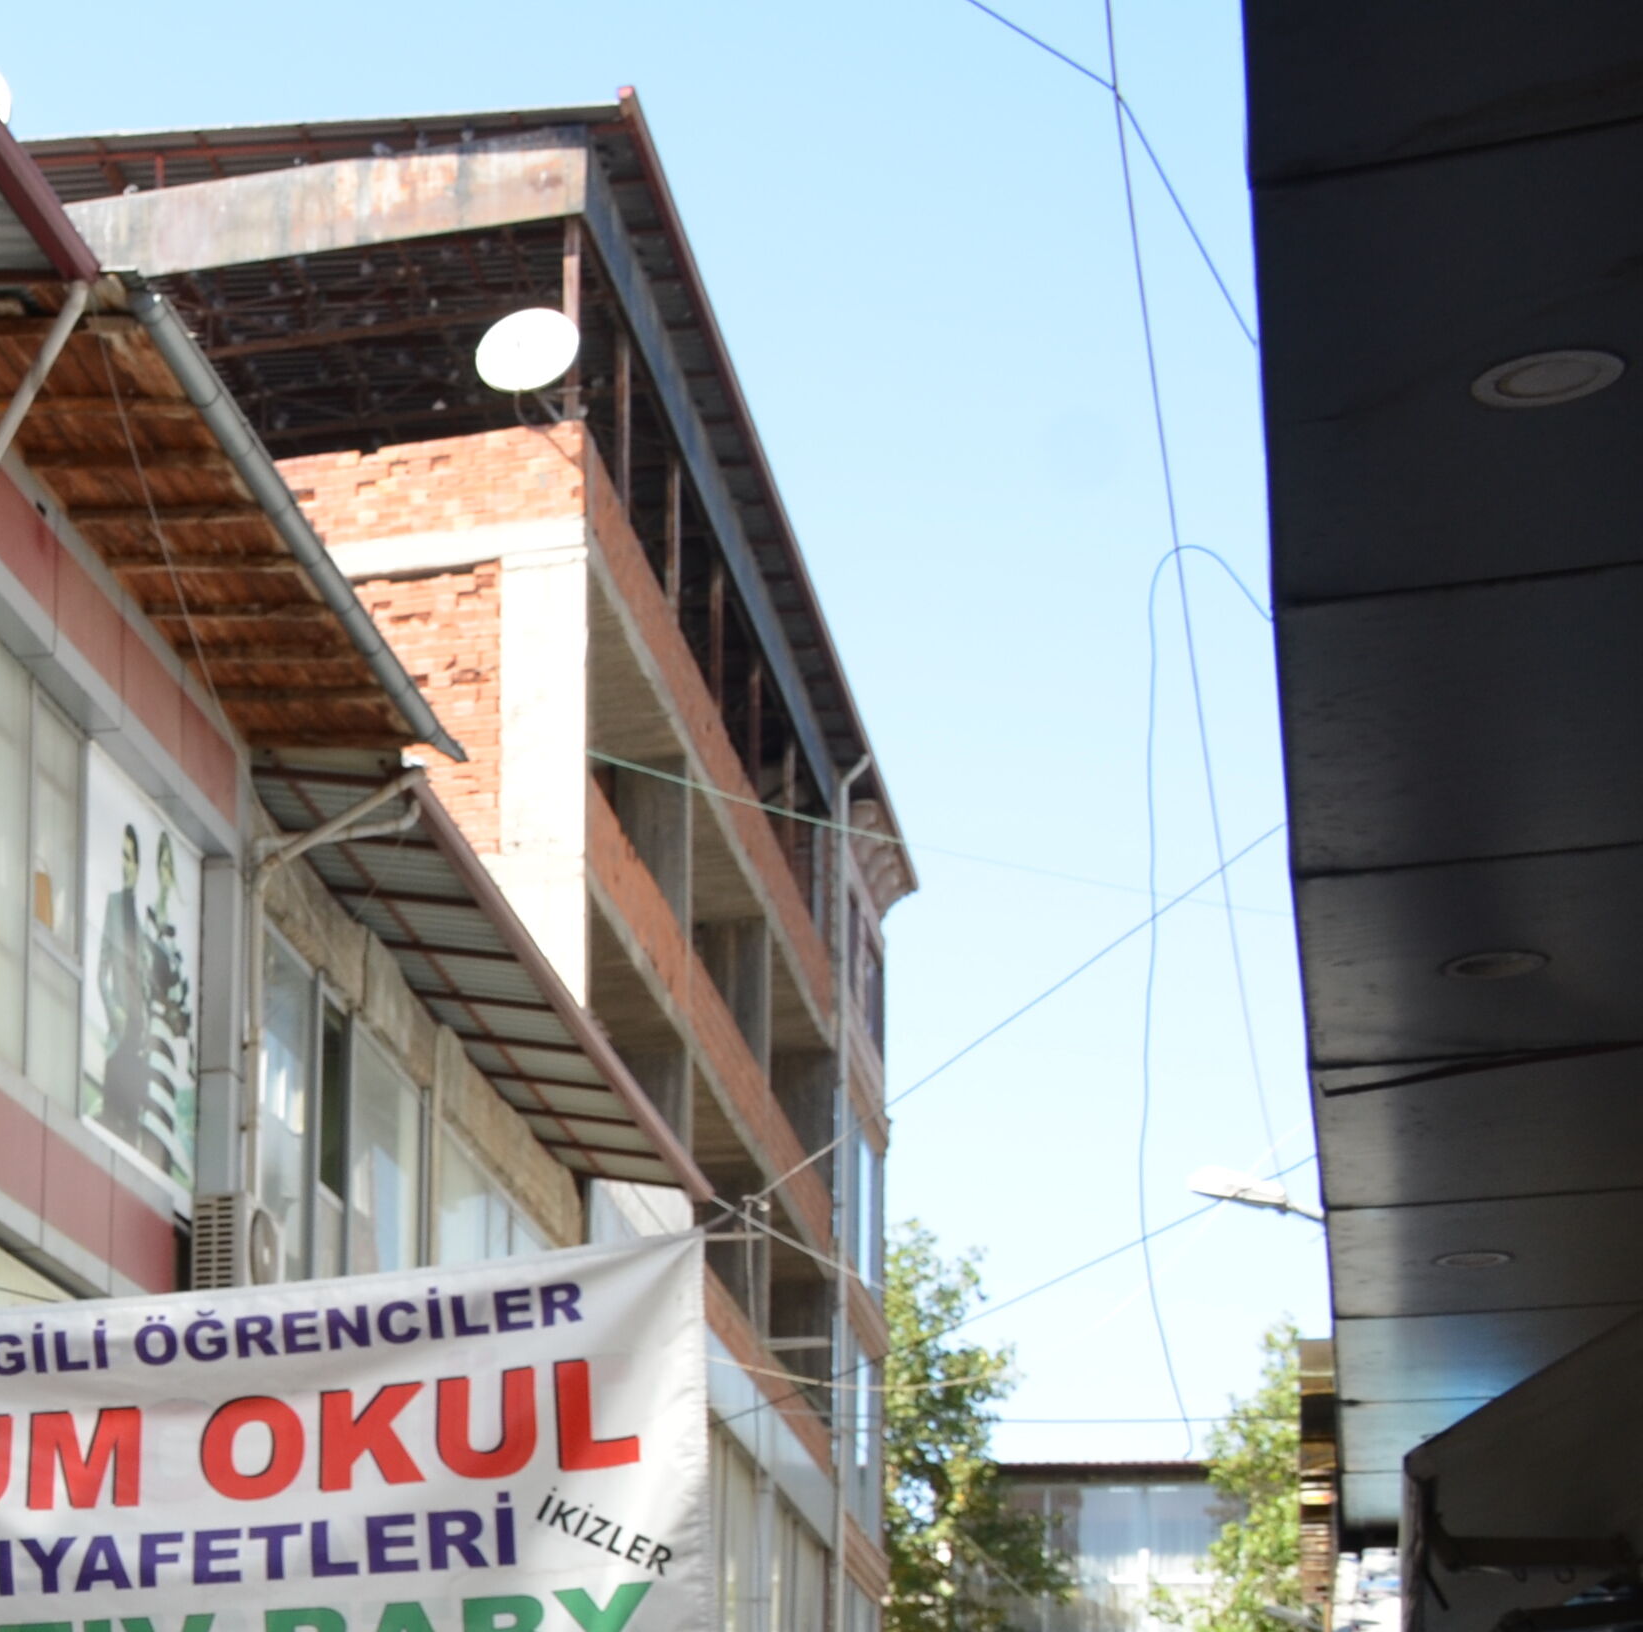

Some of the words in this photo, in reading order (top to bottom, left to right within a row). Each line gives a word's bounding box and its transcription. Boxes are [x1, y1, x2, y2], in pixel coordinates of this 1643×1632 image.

[133, 1281, 583, 1367] ÖĞRENCİLER
[199, 1359, 641, 1502] OKUL
[535, 1486, 674, 1577] İKİZLER
